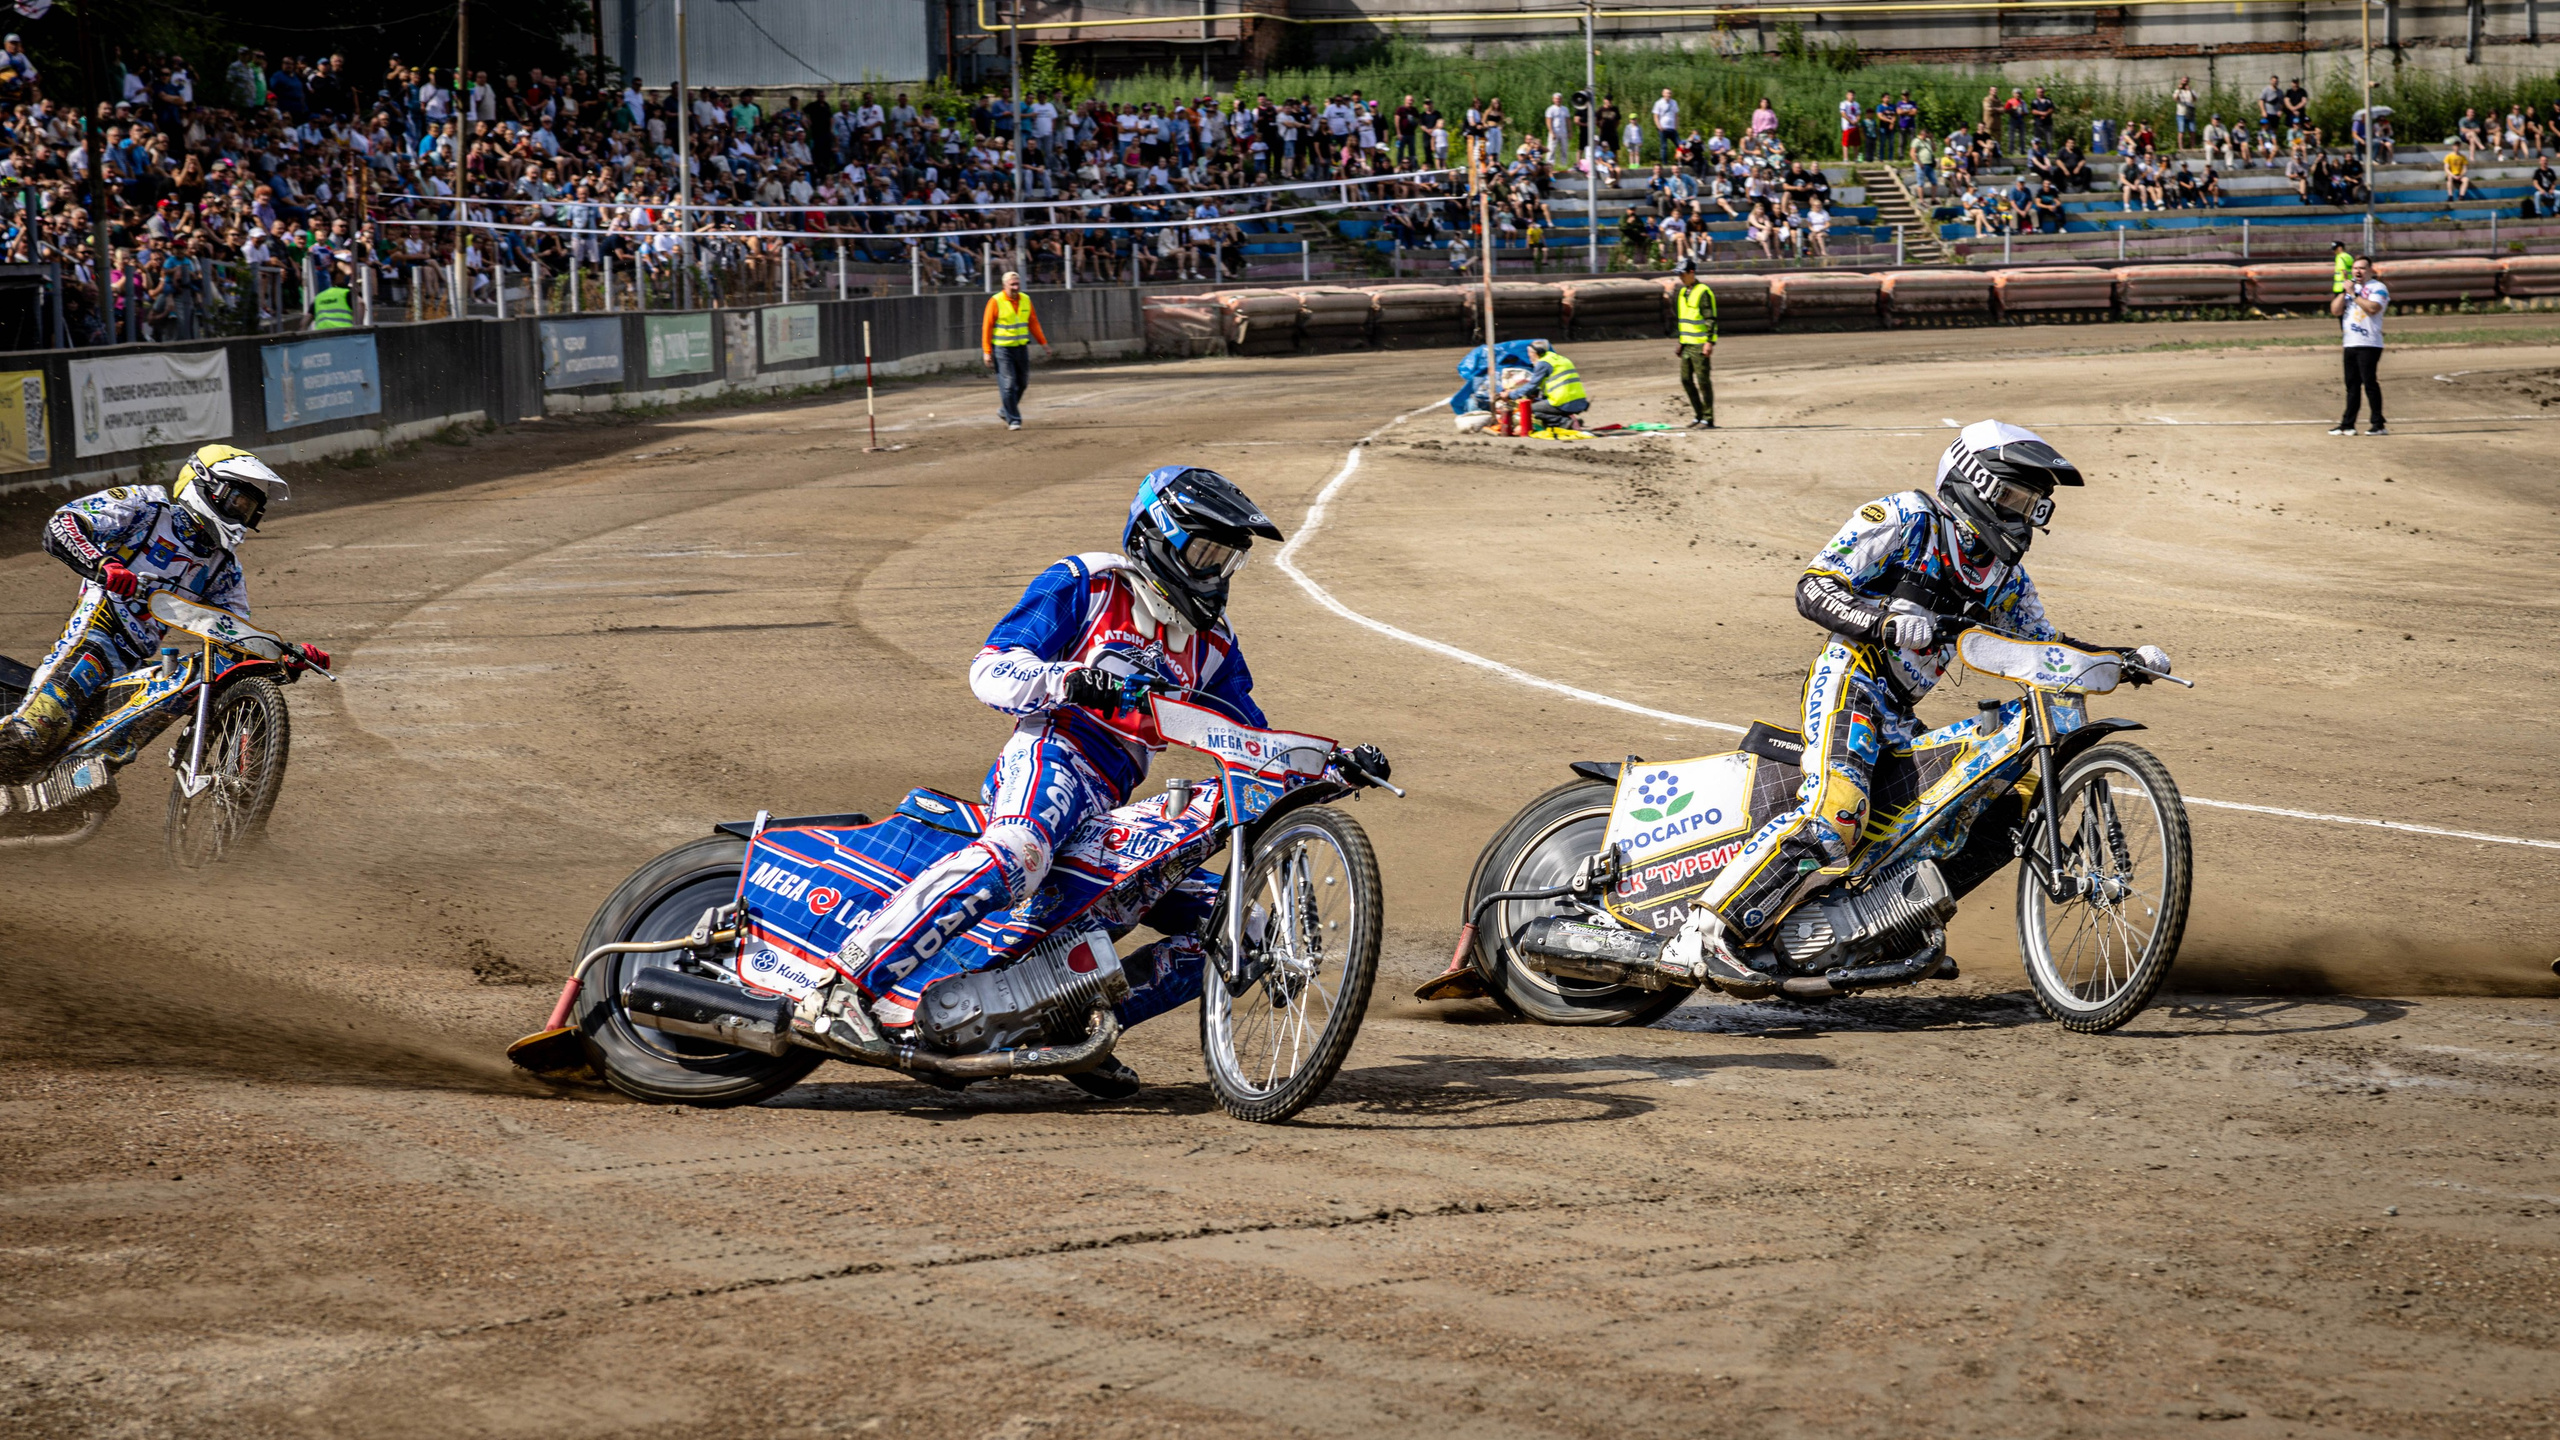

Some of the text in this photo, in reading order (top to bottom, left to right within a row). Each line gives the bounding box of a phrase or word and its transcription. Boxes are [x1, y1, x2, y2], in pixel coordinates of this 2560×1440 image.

[1094, 630, 1145, 647] АЛТЫН
[1207, 727, 1268, 743] СПОРТИВНЫЙ
[1208, 734, 1243, 751] MEGA
[1617, 808, 1722, 853] ФОСАГРО
[749, 862, 811, 902] MEGA
[1616, 840, 1746, 898] СК "ТУРБИН
[1651, 903, 1693, 930] БА
